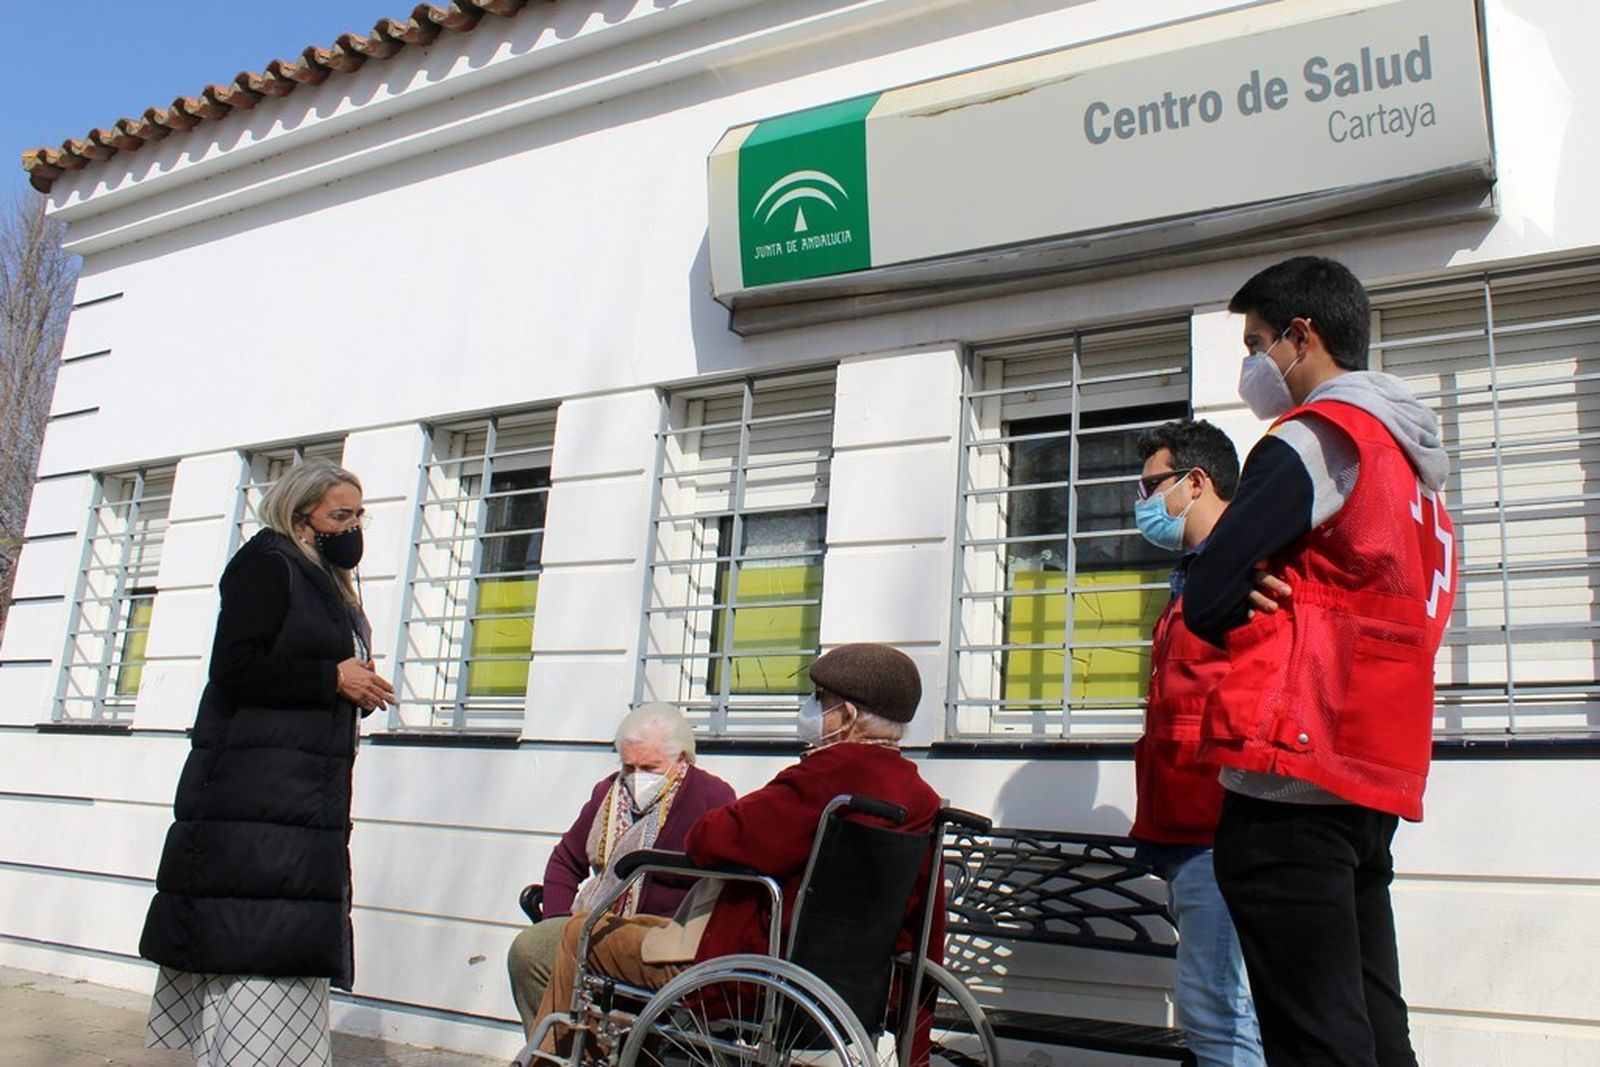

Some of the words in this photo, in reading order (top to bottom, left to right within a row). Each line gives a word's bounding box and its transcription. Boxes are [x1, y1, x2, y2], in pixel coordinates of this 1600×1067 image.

[1084, 91, 1223, 144] Centro
[1237, 70, 1289, 117] de
[1303, 35, 1432, 102] Salud
[1328, 102, 1436, 144] Cartaya
[754, 242, 782, 259] JUNTA
[786, 240, 798, 253] DE
[801, 230, 852, 250] ANDALUCIA
